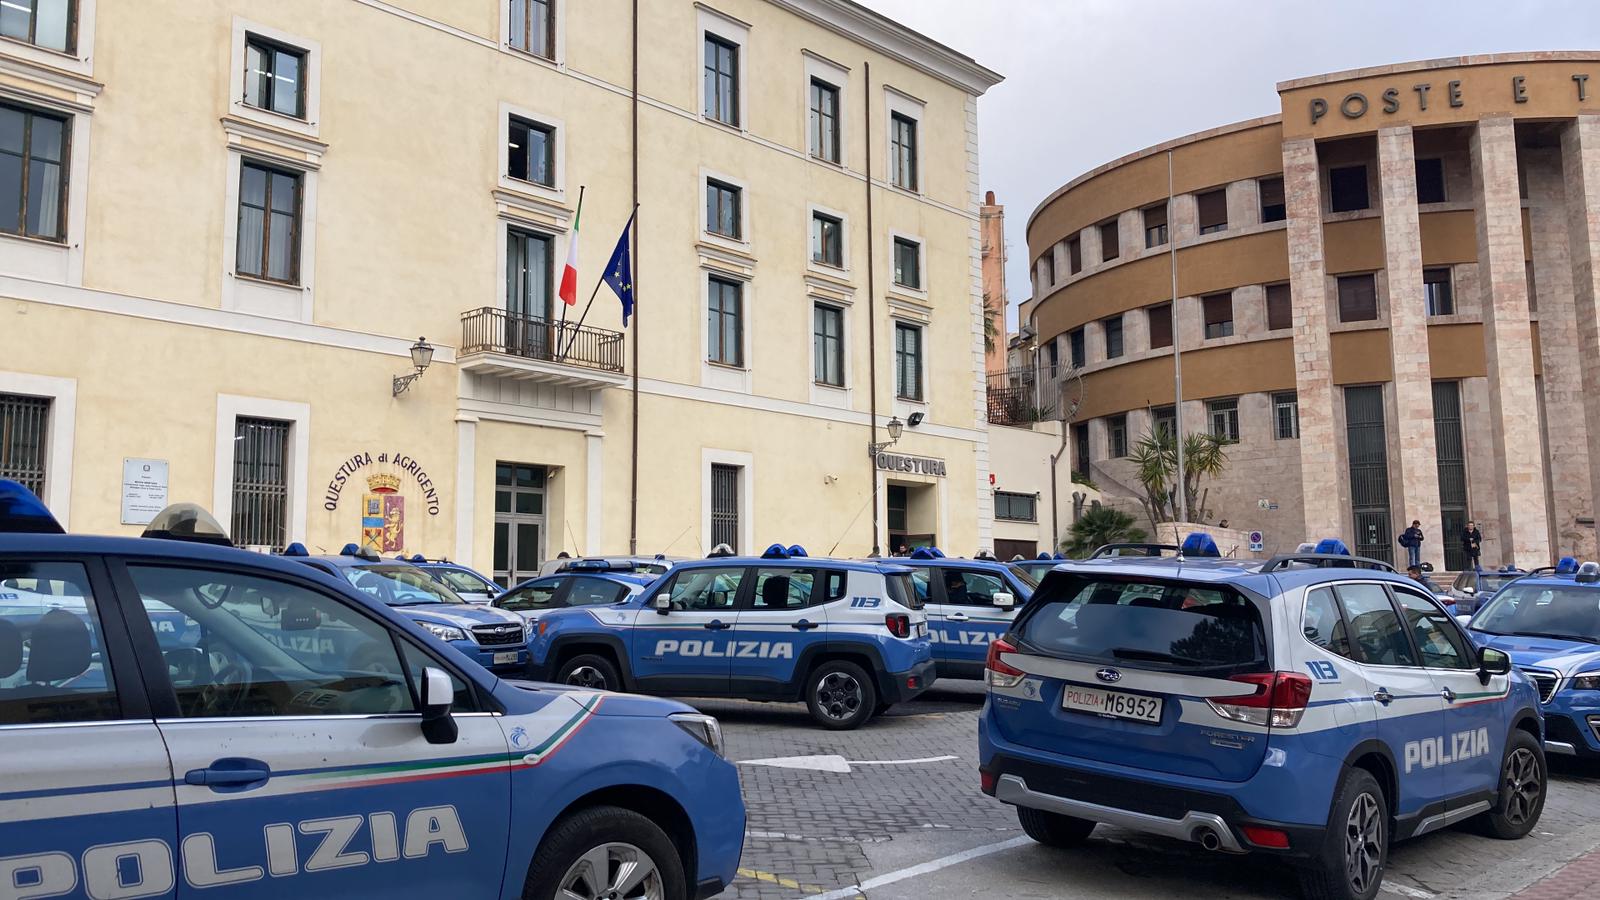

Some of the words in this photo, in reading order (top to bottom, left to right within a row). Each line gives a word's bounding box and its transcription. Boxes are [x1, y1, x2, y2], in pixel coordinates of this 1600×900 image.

[1310, 80, 1463, 125] POSTE
[1513, 76, 1528, 104] E
[1572, 74, 1589, 101] T
[877, 453, 947, 476] QUESTURA
[324, 452, 373, 511] QUESTURA
[392, 453, 440, 516] AGRIGENTO
[850, 596, 882, 608] 113
[263, 633, 336, 654] OLIZIA
[654, 639, 793, 659] POLIZIA
[926, 629, 1006, 647] OLIZI
[1305, 660, 1339, 680] 113
[1066, 690, 1099, 706] POLIZIA
[1104, 693, 1157, 719] M6952
[1404, 727, 1490, 774] POLIZIA
[0, 804, 470, 900] POLIZIA
